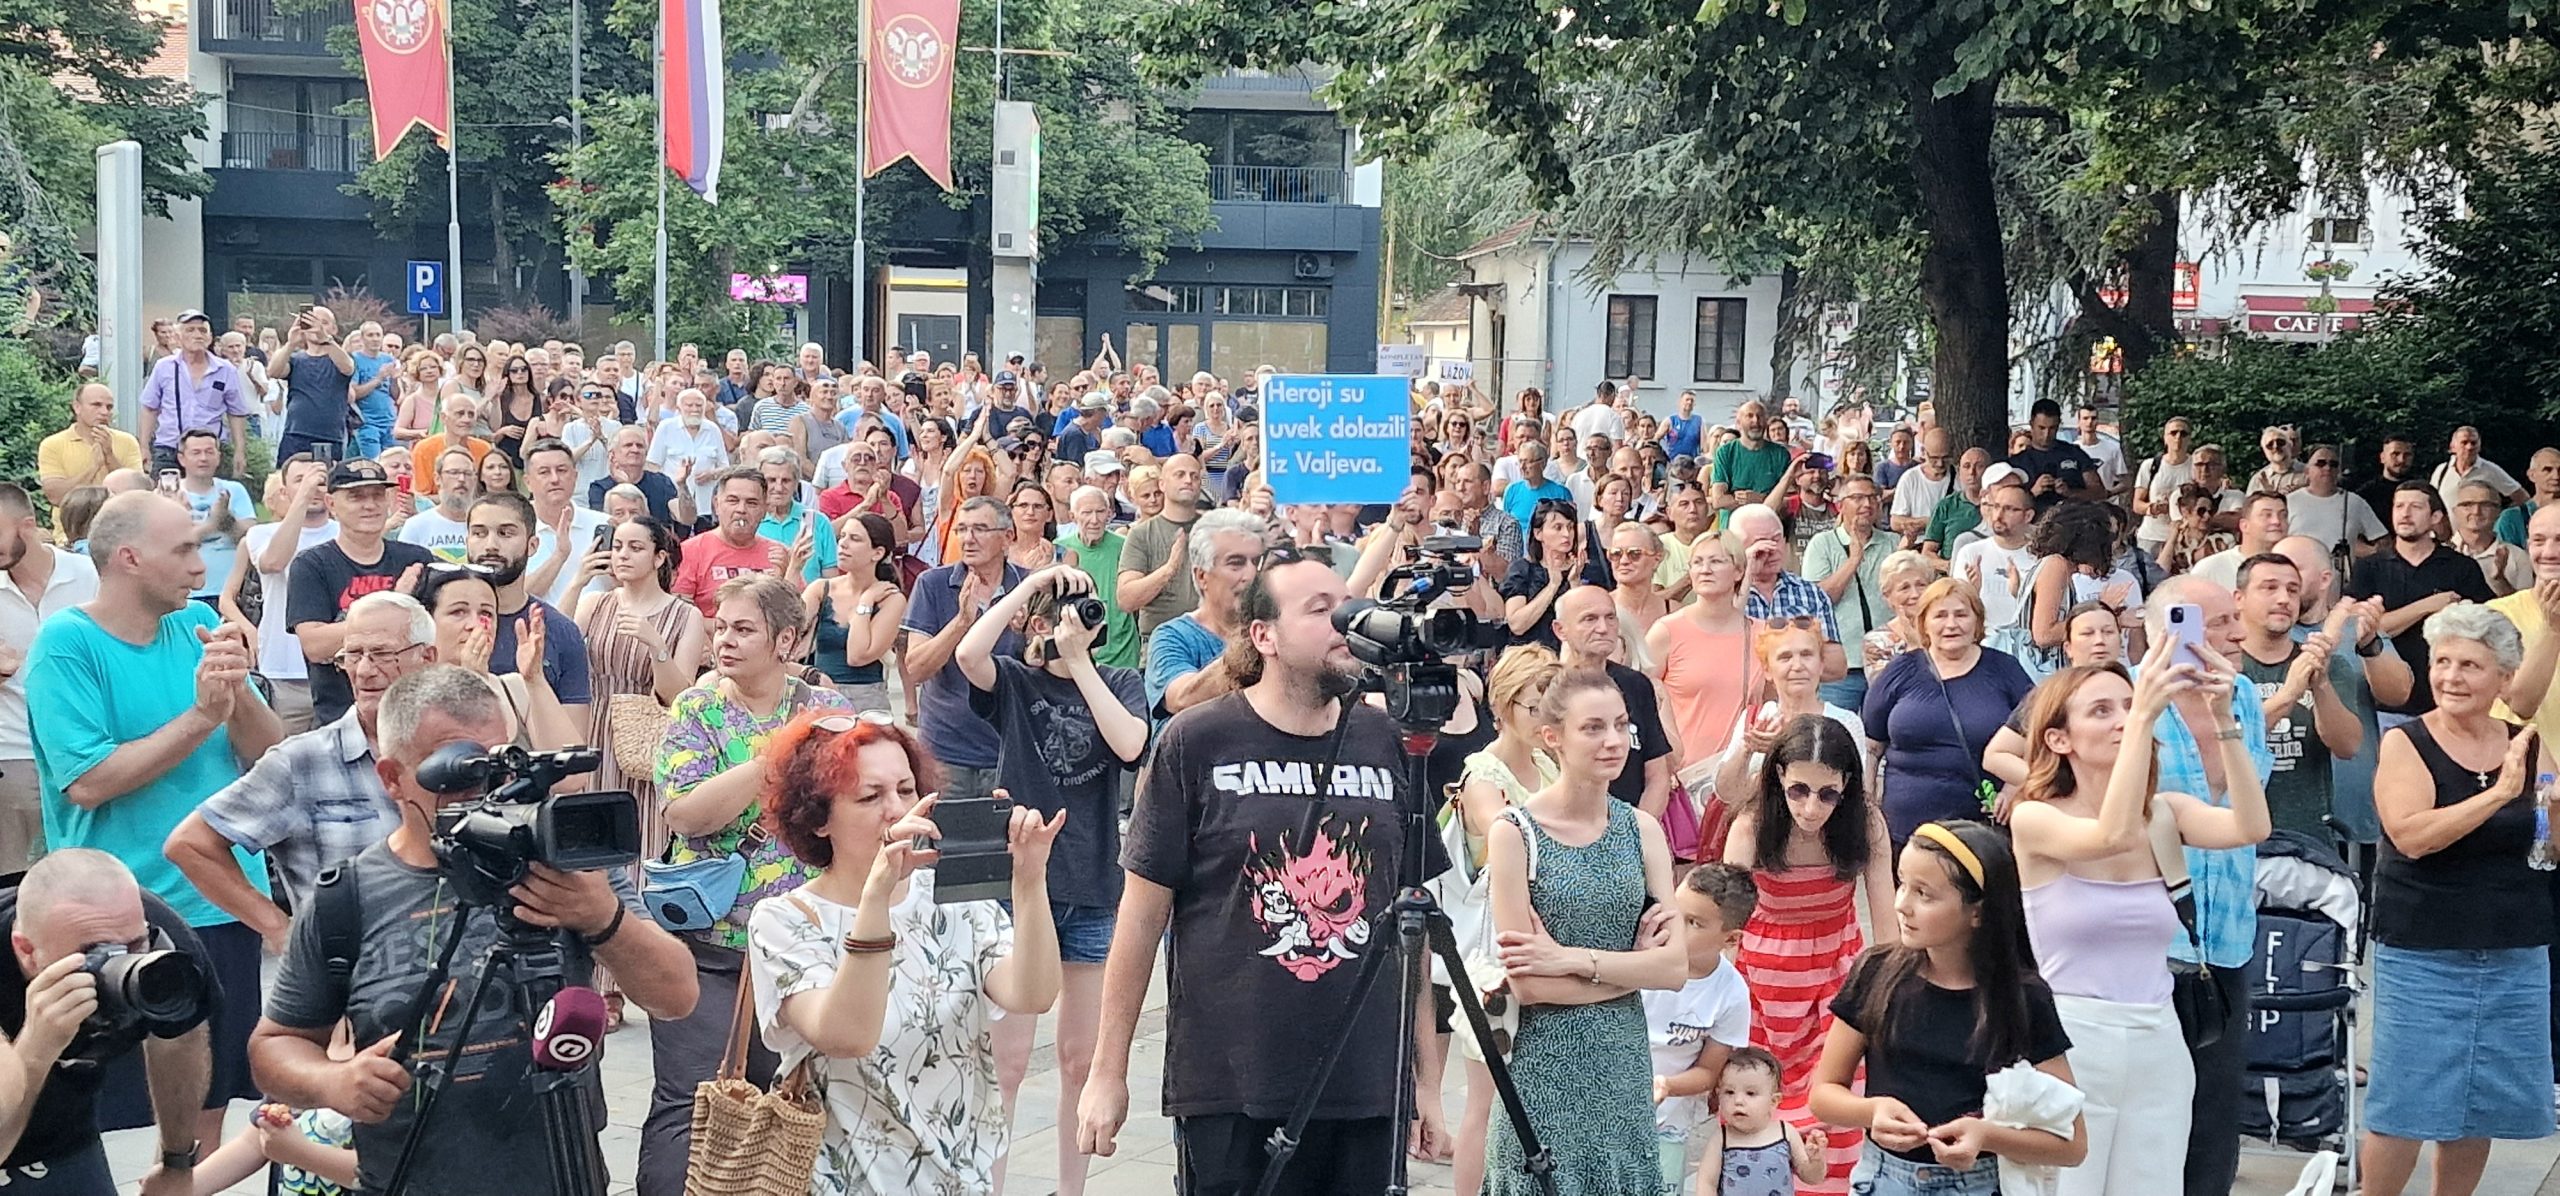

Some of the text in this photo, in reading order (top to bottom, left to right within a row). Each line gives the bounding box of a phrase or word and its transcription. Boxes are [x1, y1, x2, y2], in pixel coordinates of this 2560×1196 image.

[416, 265, 434, 293] P
[1268, 381, 1365, 410] Heroji su
[1269, 415, 1406, 439] uvek dolazili
[1270, 450, 1383, 480] iz Valjeva.
[428, 534, 466, 547] JAMA
